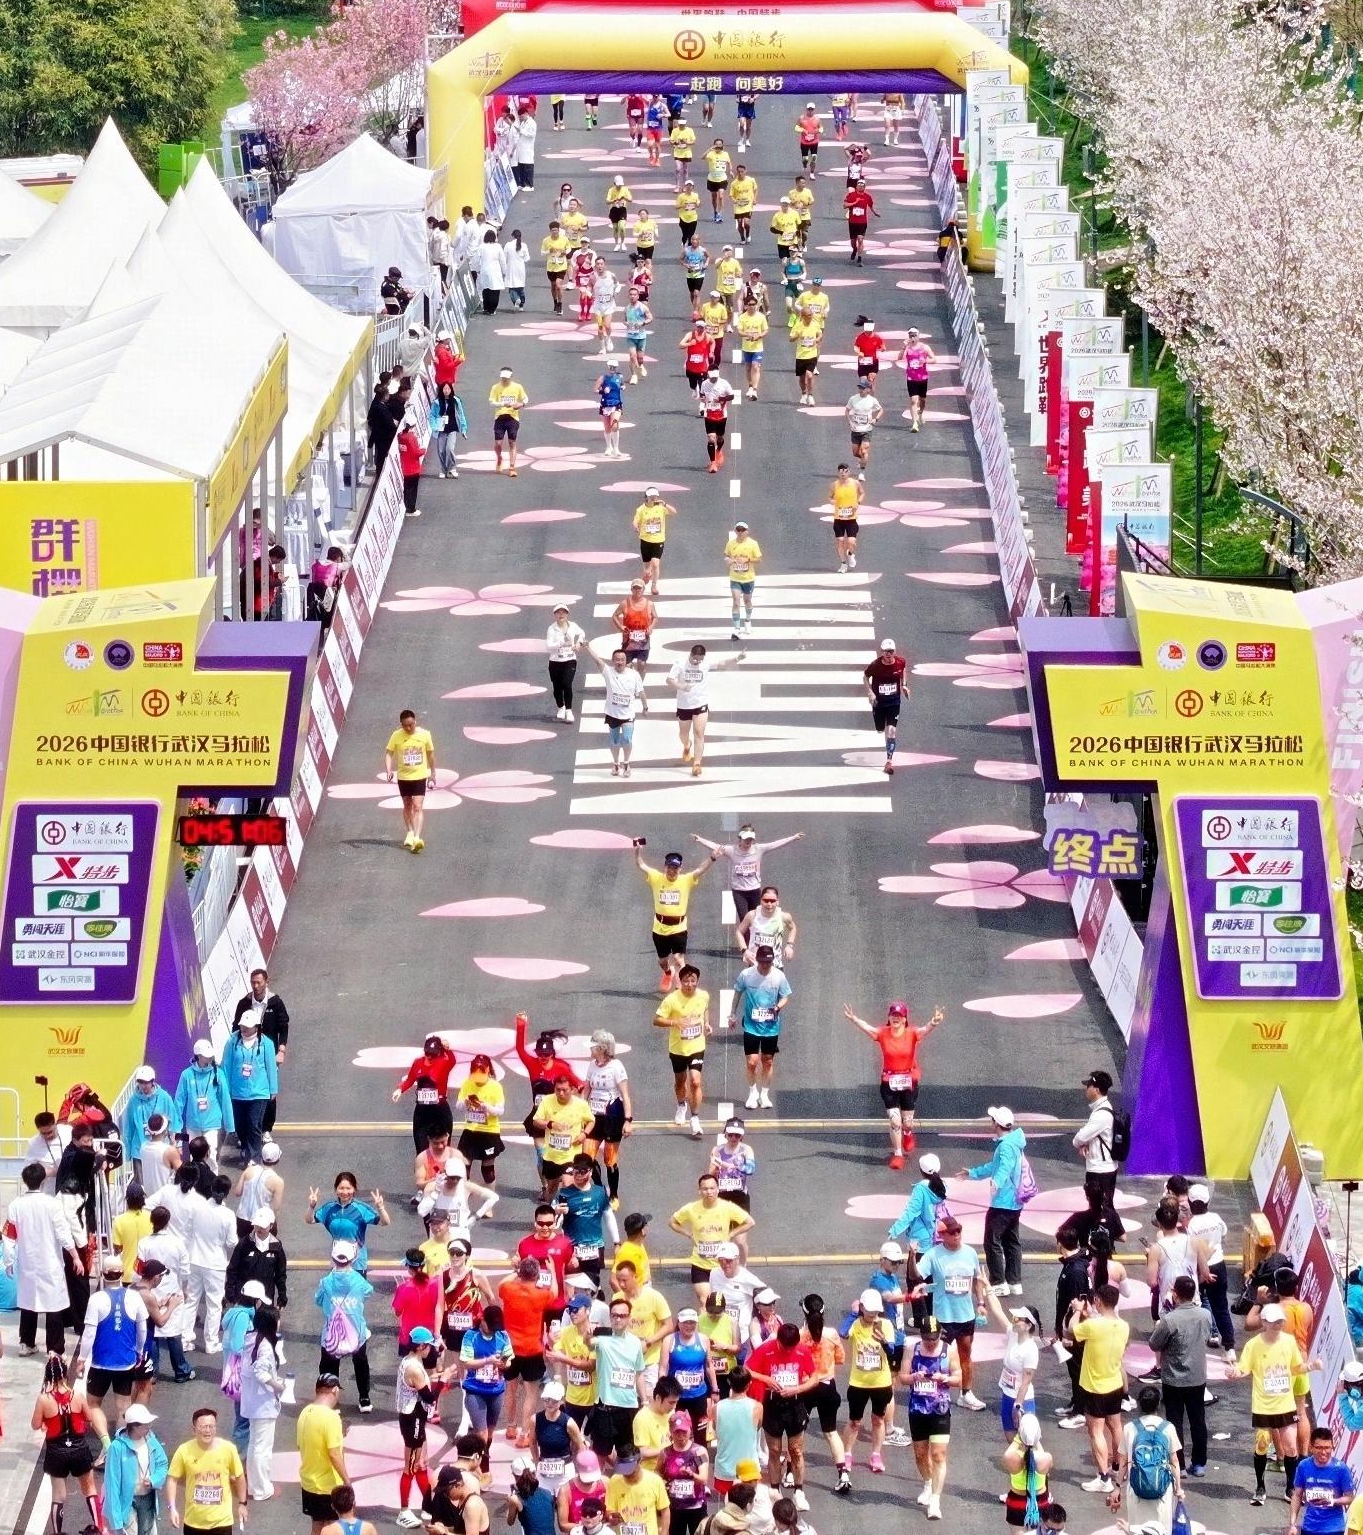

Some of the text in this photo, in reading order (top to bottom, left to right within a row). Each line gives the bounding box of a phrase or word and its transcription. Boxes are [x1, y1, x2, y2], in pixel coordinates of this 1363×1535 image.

[675, 77, 783, 91] 一起跑 向美好
[36, 734, 270, 754] 2026中国银行武汉马拉松
[1070, 735, 1303, 754] 2026中国银行武汉马拉松
[36, 758, 271, 767] BANK OF CHINA WUHAN MARATHON
[1070, 758, 1304, 767] BANK OF CHINA WUHAN MARATHON
[1053, 833, 1139, 874] 终点
[22, 923, 66, 936] 勇闯天涯
[1212, 919, 1255, 931] 勇闯天涯
[28, 950, 66, 959] 武汉金控
[1224, 946, 1261, 955] 武汉金控
